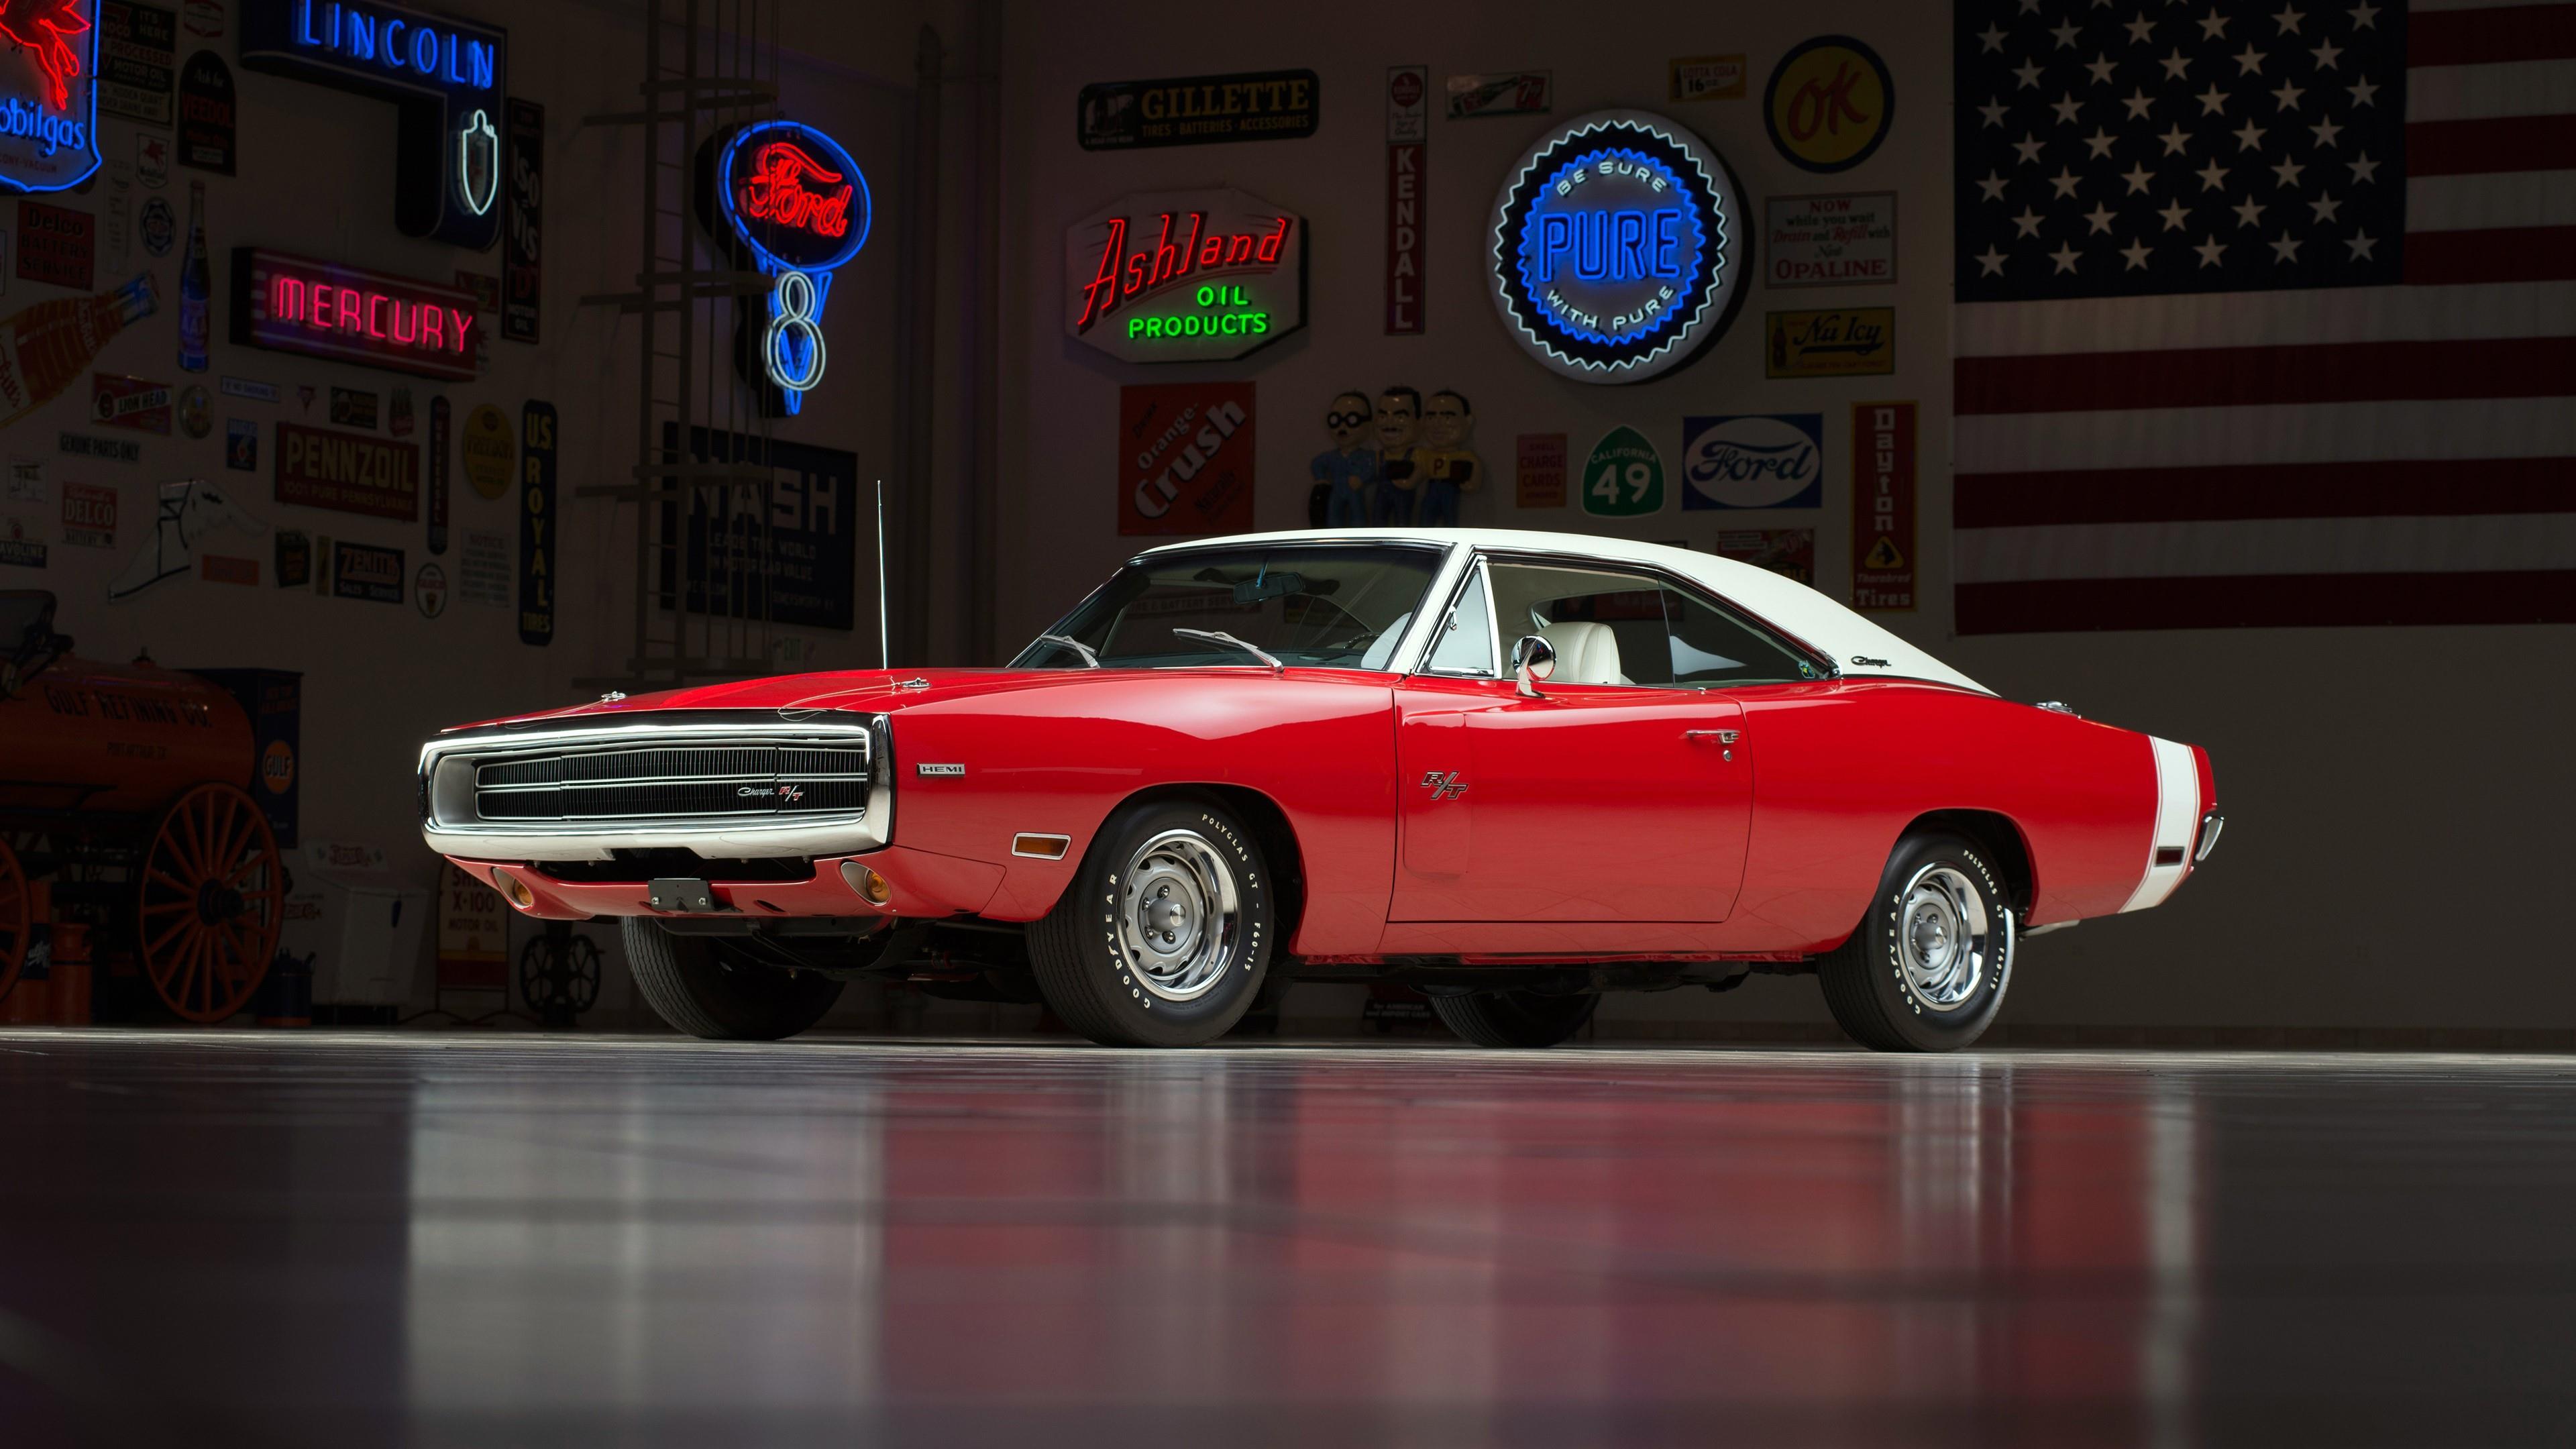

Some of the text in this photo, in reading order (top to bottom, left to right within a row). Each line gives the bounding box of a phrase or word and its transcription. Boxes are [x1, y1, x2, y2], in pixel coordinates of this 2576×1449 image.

[111, 42, 172, 65] PROCESSED
[299, 0, 494, 89] LINCOLN
[1683, 64, 1738, 79] LOTTA COLA
[1687, 78, 1705, 93] 16
[182, 93, 234, 128] VEEDOL
[1141, 78, 1311, 121] GILLETTE
[1788, 59, 1871, 142] OK
[0, 96, 86, 158] obilgas
[1142, 114, 1309, 138] TIRES BATTERIES ACCESSORIES
[0, 153, 58, 172] ONY-VACUUM
[749, 141, 853, 237] Ford
[1556, 161, 1668, 197] BE SURE
[1786, 211, 1876, 228] while you wait
[1810, 199, 1852, 213] NOW
[28, 205, 85, 238] Delco
[1772, 229, 1811, 244] Drain
[1833, 224, 1869, 246] Refill
[1868, 226, 1891, 239] with
[1393, 146, 1417, 329] KENDALL
[1538, 208, 1683, 282] PURE
[1077, 212, 1287, 326] Ashland
[1775, 258, 1888, 280] OPALINE
[1197, 285, 1250, 307] OIL
[1547, 284, 1674, 330] WITH PURE
[276, 276, 474, 354] MERCURY
[1128, 312, 1267, 339] PRODUCTS
[118, 390, 167, 413] LION HEAD
[93, 438, 119, 458] PARTS
[120, 440, 140, 462] ONLY
[284, 431, 415, 492] PENNZOIL
[1134, 399, 1248, 519] Crush
[1519, 454, 1564, 469] CHARGE
[1590, 447, 1657, 465] CALIFORNIA
[1690, 439, 1813, 482] Ford
[1523, 472, 1562, 488] CARDS
[1591, 463, 1652, 504] 49
[1873, 408, 1895, 531] Dayton
[687, 451, 838, 537] NASH
[64, 498, 114, 527] DELCO
[525, 455, 548, 608] ROYAL
[0, 541, 44, 557] AVOLINE
[777, 539, 816, 561] WORLD
[339, 547, 400, 584] ZENITH
[782, 561, 814, 584] VALUE
[1207, 596, 1234, 608] SERV
[1856, 590, 1911, 607] Tires
[521, 612, 551, 633] TIRES
[1850, 655, 1892, 669] Charger
[43, 684, 89, 717] GULF
[94, 688, 178, 725] REFINING
[264, 755, 291, 780] GULF
[737, 785, 805, 802] Charger R/T
[1420, 771, 1469, 800] R/T
[1201, 813, 1248, 862] POLYGLAS
[1248, 873, 1258, 889] GT
[1963, 849, 1998, 895] POLYGLAS
[1996, 904, 2004, 919] GT
[446, 917, 499, 933] MOTOR OIL
[1106, 873, 1150, 1009] GOODYEAR
[1244, 922, 1261, 971] F60-15
[1889, 894, 1921, 1014] GOODYEAR
